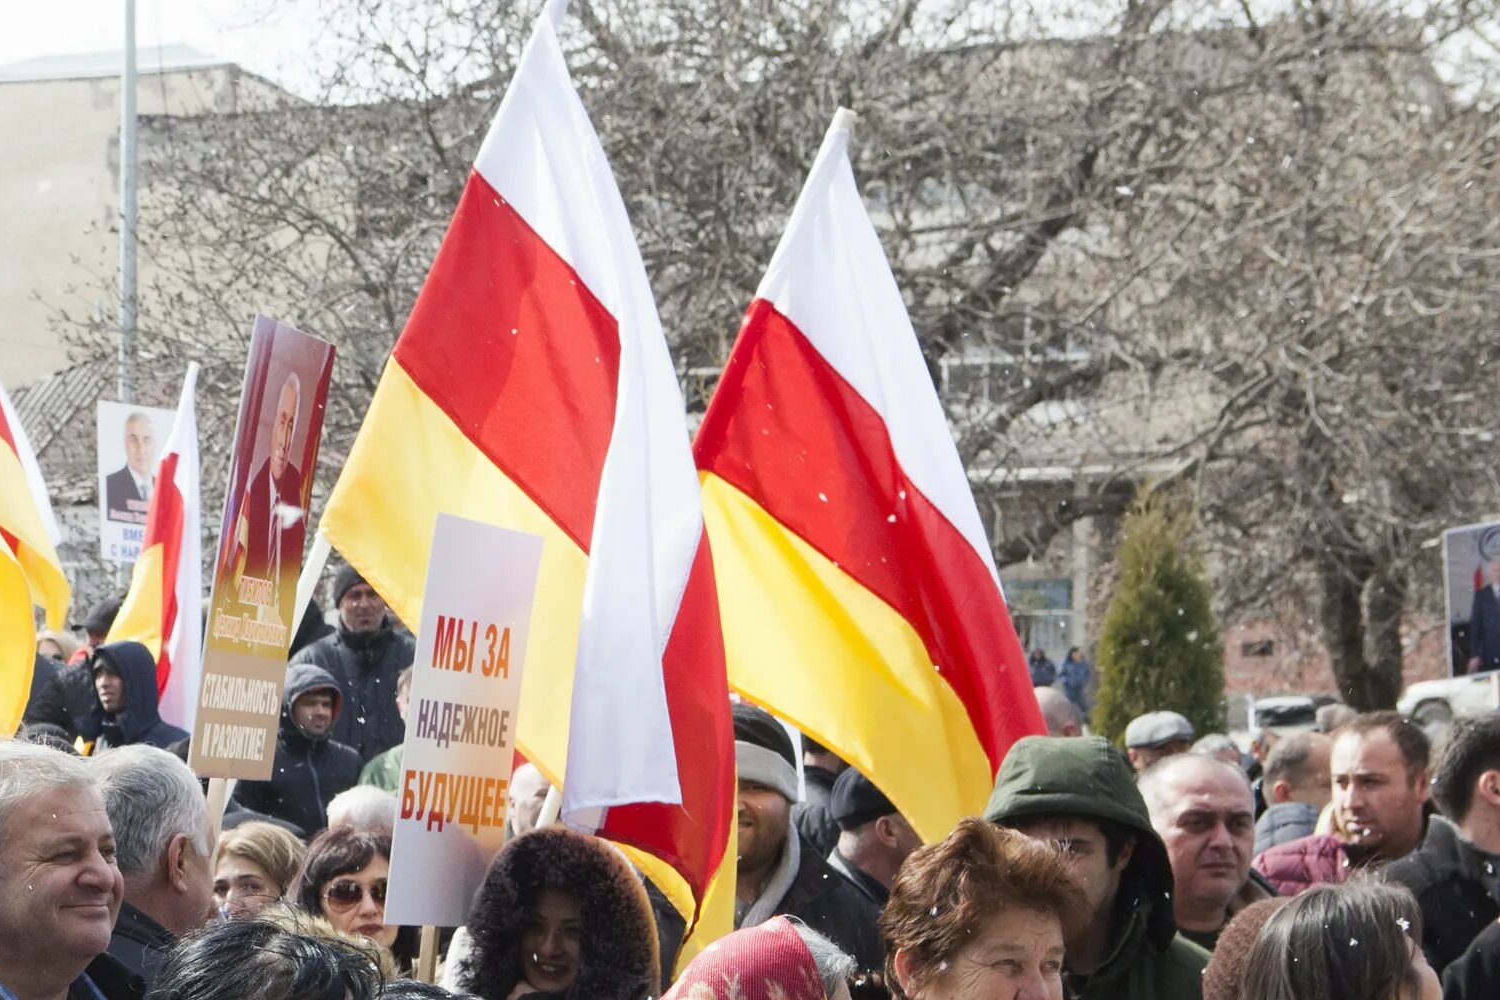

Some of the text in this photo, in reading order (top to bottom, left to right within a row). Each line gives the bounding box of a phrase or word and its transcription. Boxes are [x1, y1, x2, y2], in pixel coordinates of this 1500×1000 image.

[432, 614, 511, 680] МЫ ЗА
[201, 672, 278, 716] СТАБИЛЬНОСТЬ
[201, 722, 267, 761] И РАЗВИТИЕ!
[416, 698, 510, 749] НАДЕЖНОЕ
[400, 769, 509, 835] БУДУЩЕЕ
